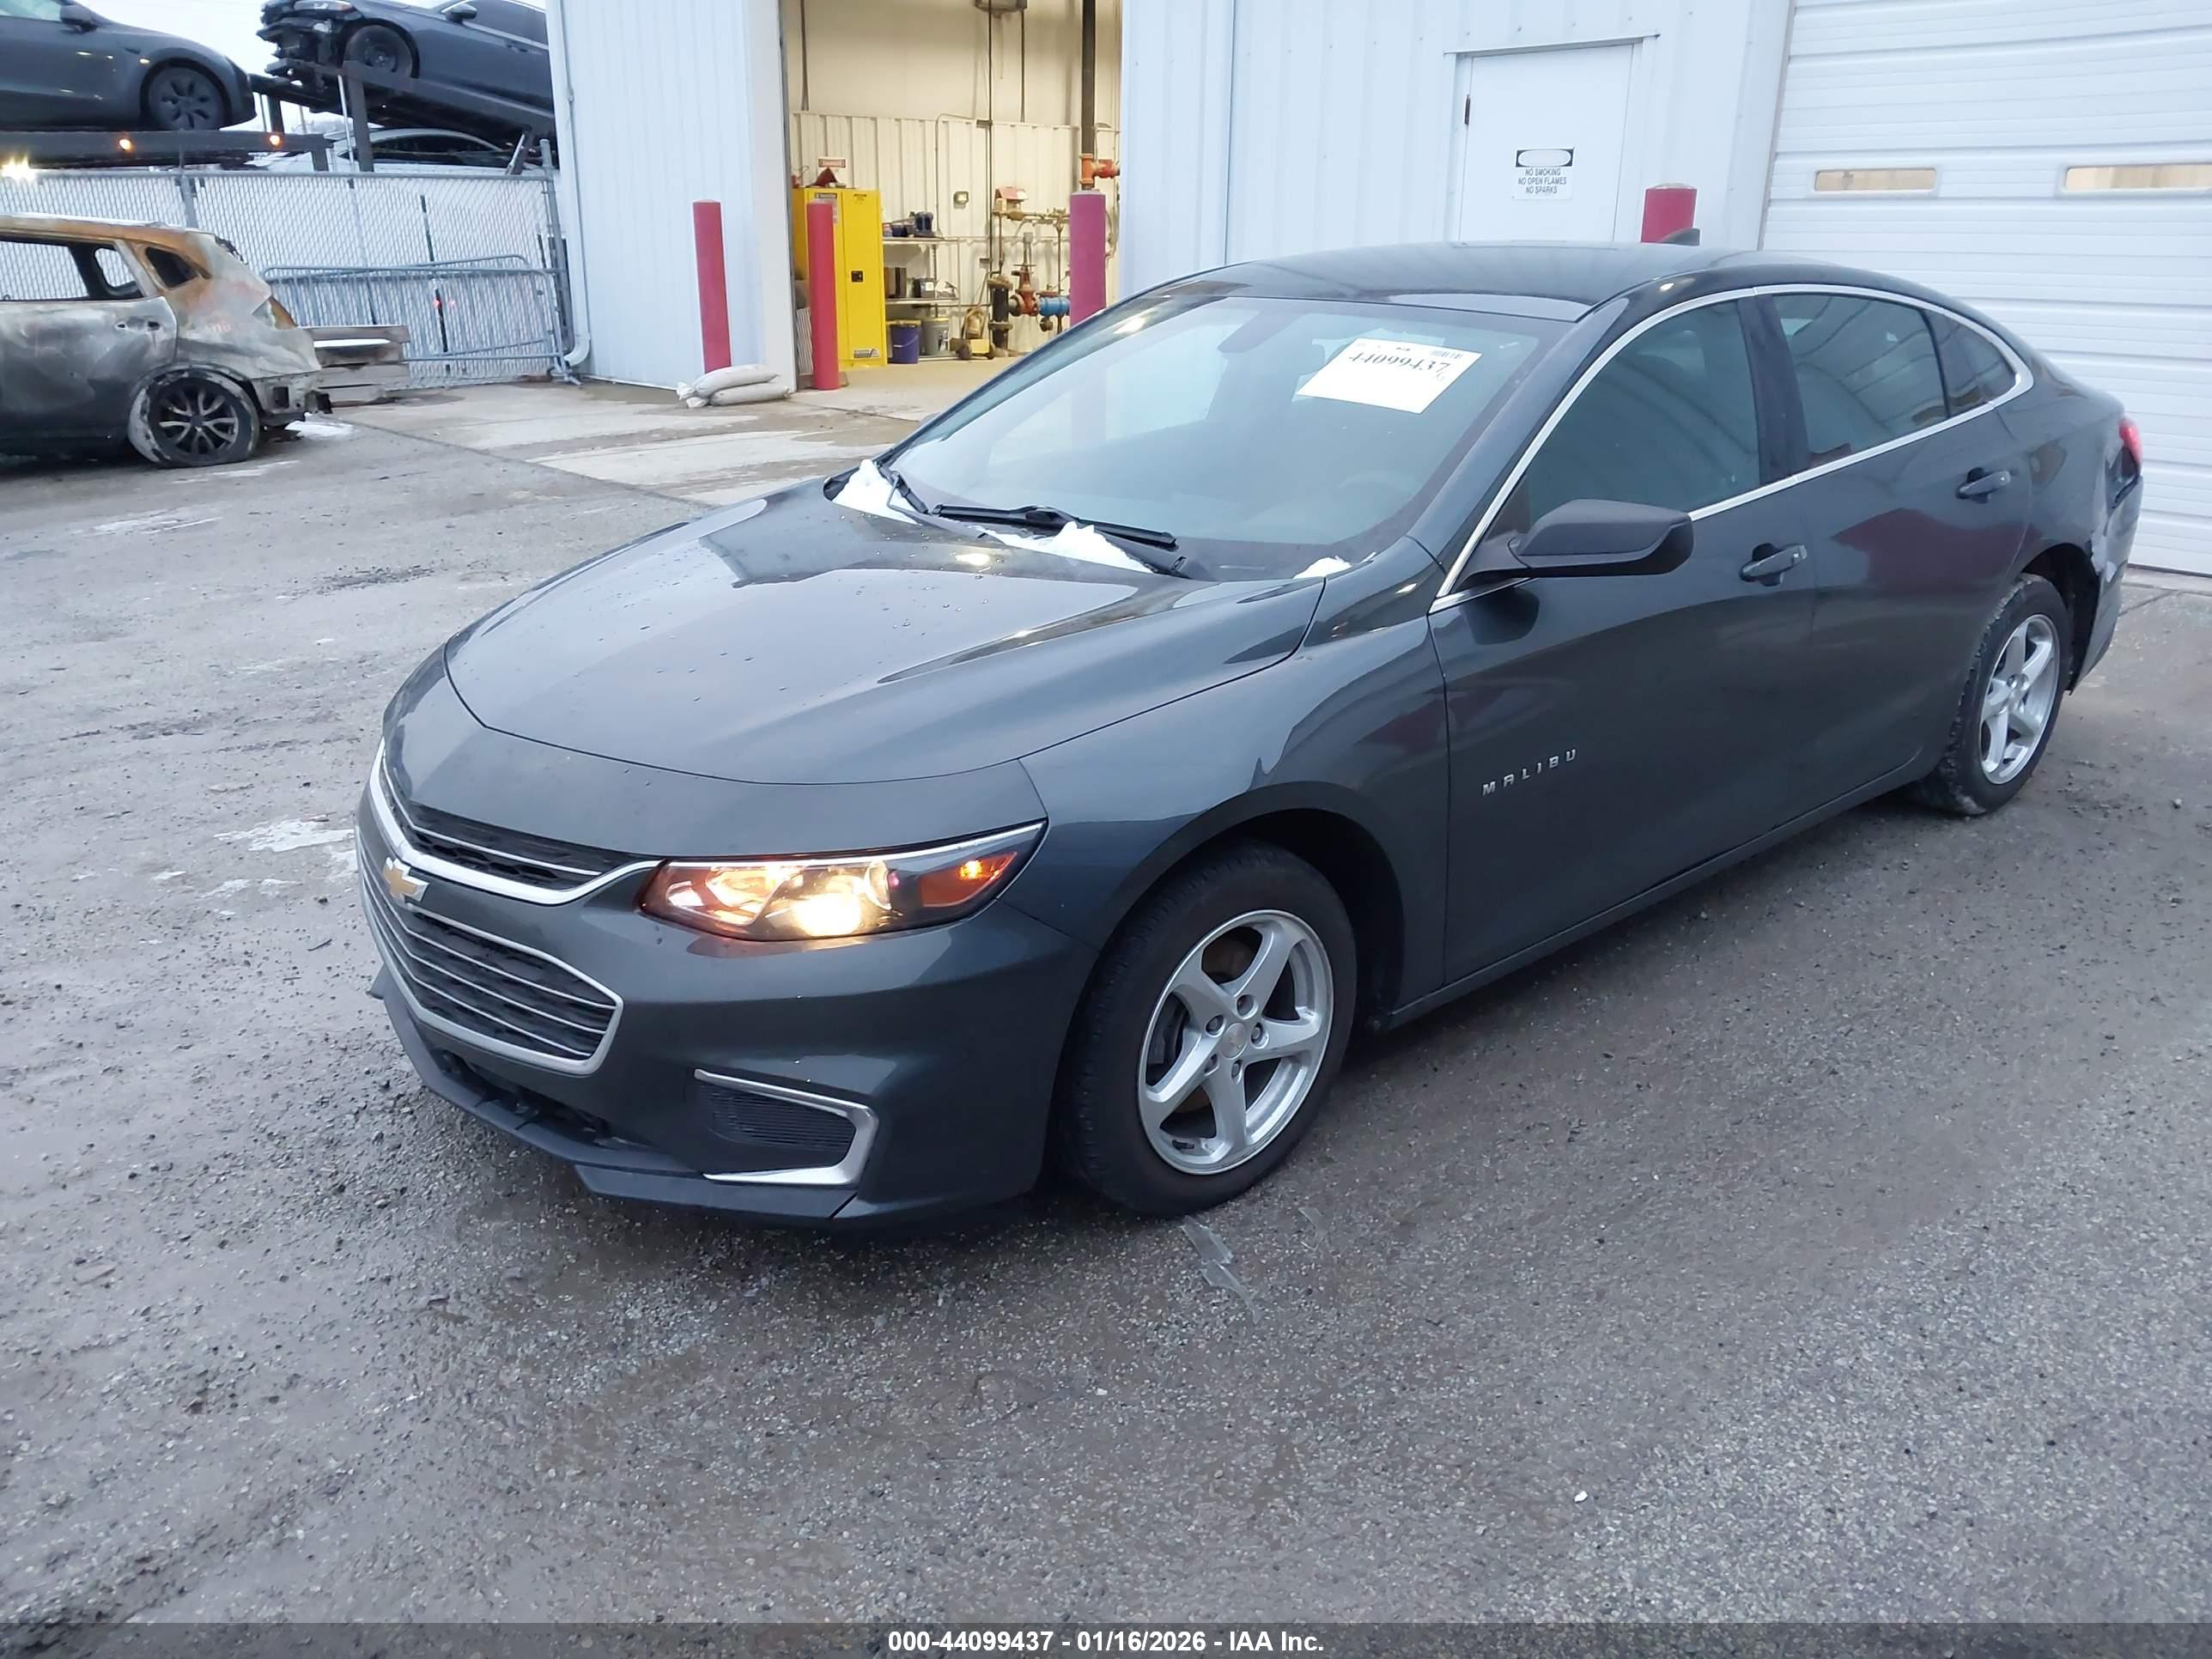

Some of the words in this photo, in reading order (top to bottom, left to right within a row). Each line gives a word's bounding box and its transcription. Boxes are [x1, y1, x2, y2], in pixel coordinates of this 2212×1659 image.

[1525, 167, 1534, 176] NO
[1534, 167, 1561, 176] SMOKING
[1518, 177, 1526, 185] NO
[1544, 176, 1567, 185] FLAMES
[1534, 185, 1558, 194] SPARKS
[1348, 351, 1450, 373] 44099437
[1482, 748, 1577, 797] MALIBU
